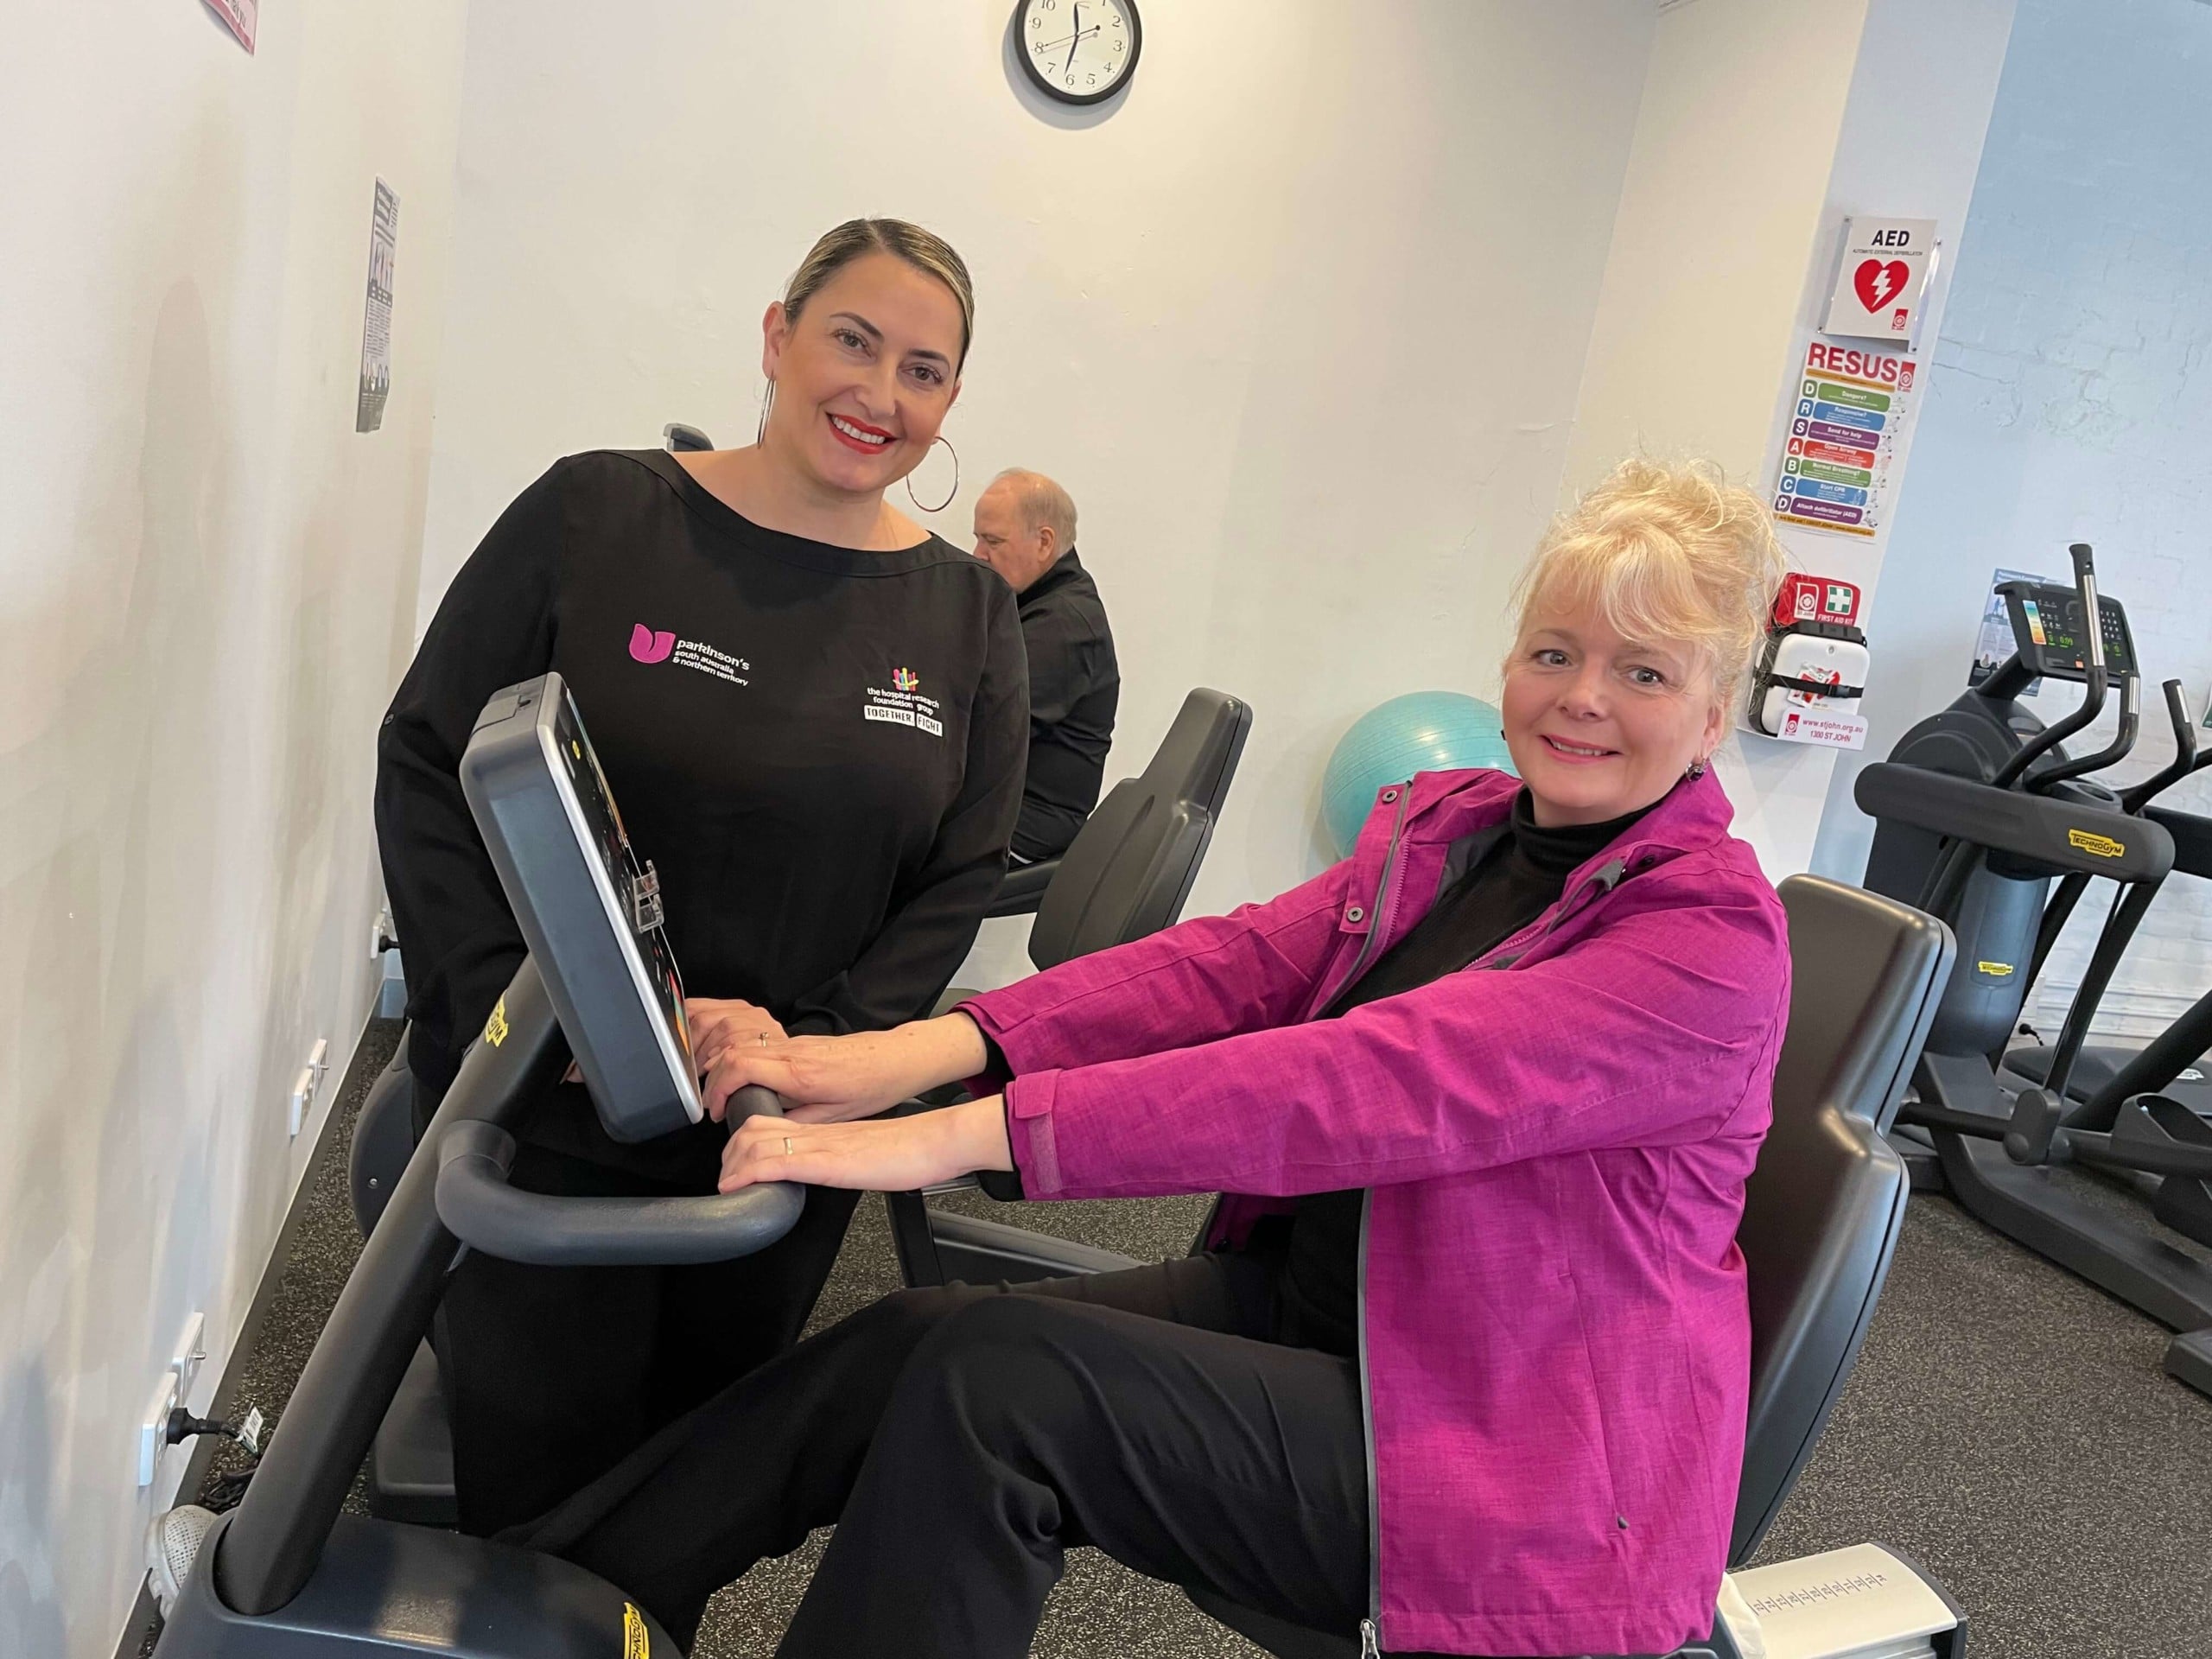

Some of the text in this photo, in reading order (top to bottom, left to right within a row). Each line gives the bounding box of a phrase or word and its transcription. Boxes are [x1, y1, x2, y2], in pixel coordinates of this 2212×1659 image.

[1032, 17, 1041, 29] 9
[1112, 16, 1121, 27] 2
[1033, 41, 1044, 54] 8
[1113, 40, 1122, 52] 3
[1047, 62, 1056, 73] 7
[1103, 61, 1113, 73] 4
[1065, 73, 1076, 86] 6
[1086, 73, 1096, 85] 5
[1871, 229, 1910, 247] AED
[1807, 342, 1898, 383] RESUS
[1805, 382, 1815, 395] D
[1800, 402, 1811, 414] R
[1796, 422, 1805, 434] S
[1790, 441, 1800, 453] A
[1788, 460, 1797, 471] B
[1783, 479, 1794, 491] C
[1778, 498, 1788, 509] D
[1817, 613, 1834, 622] FIRST
[677, 639, 750, 671] parkinson's
[675, 650, 734, 674] south australia
[680, 659, 716, 676] northern
[716, 671, 749, 687] territory
[867, 687, 940, 709] the hospital research
[873, 696, 934, 716] foundation group
[1802, 719, 1864, 734] www.stjohn.org.au
[1810, 730, 1824, 739] 1300
[1834, 733, 1852, 742] JOHN
